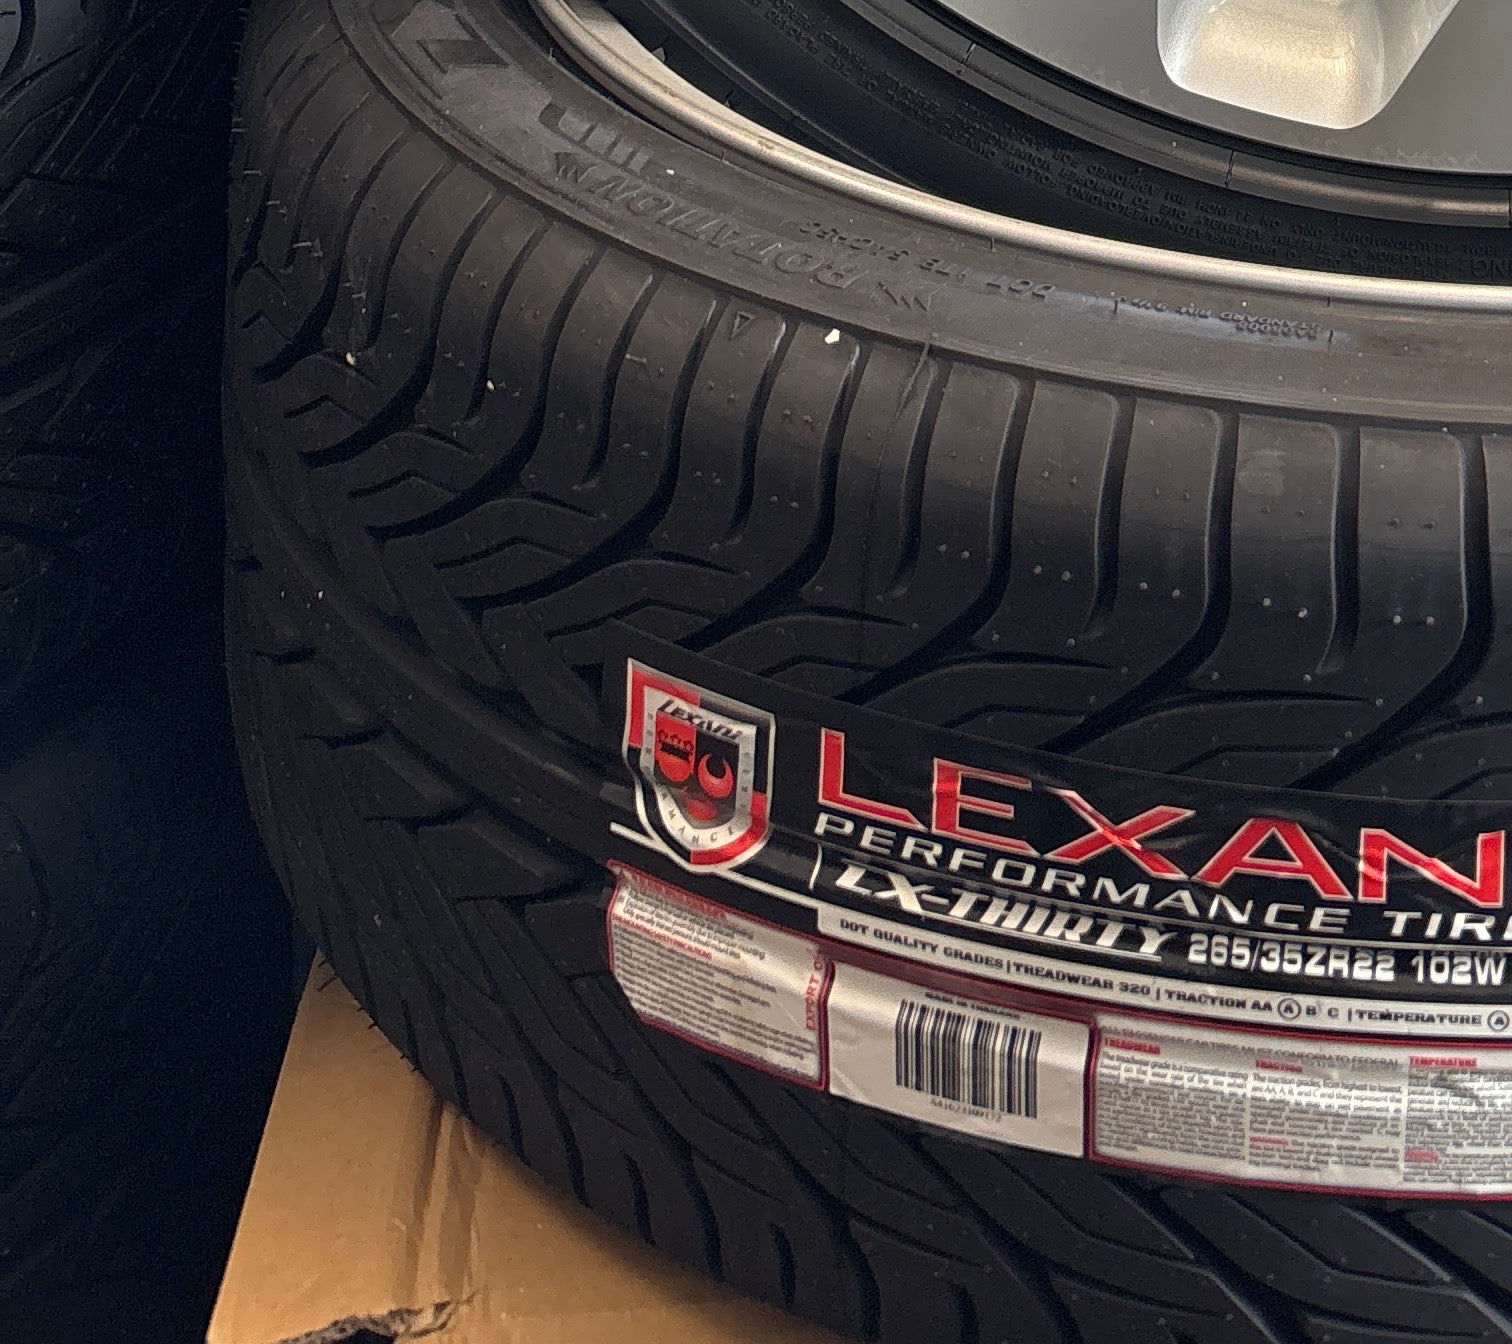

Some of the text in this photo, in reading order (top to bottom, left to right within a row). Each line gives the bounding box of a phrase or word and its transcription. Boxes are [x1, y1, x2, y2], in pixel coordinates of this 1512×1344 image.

[813, 811, 1351, 936] PERFORMANCE
[833, 859, 1179, 959] LX-THIRTY
[1187, 930, 1396, 983] 265/35ZR22
[1410, 952, 1508, 987] 102W
[839, 917, 868, 936] DOT
[872, 928, 939, 956] QUALITY
[943, 946, 1004, 971] GRADES
[1014, 962, 1114, 992] TREADWEAR
[1118, 981, 1151, 997] 320
[1165, 988, 1247, 1010] TRACTION
[1355, 1008, 1483, 1026] TEMPERATURE
